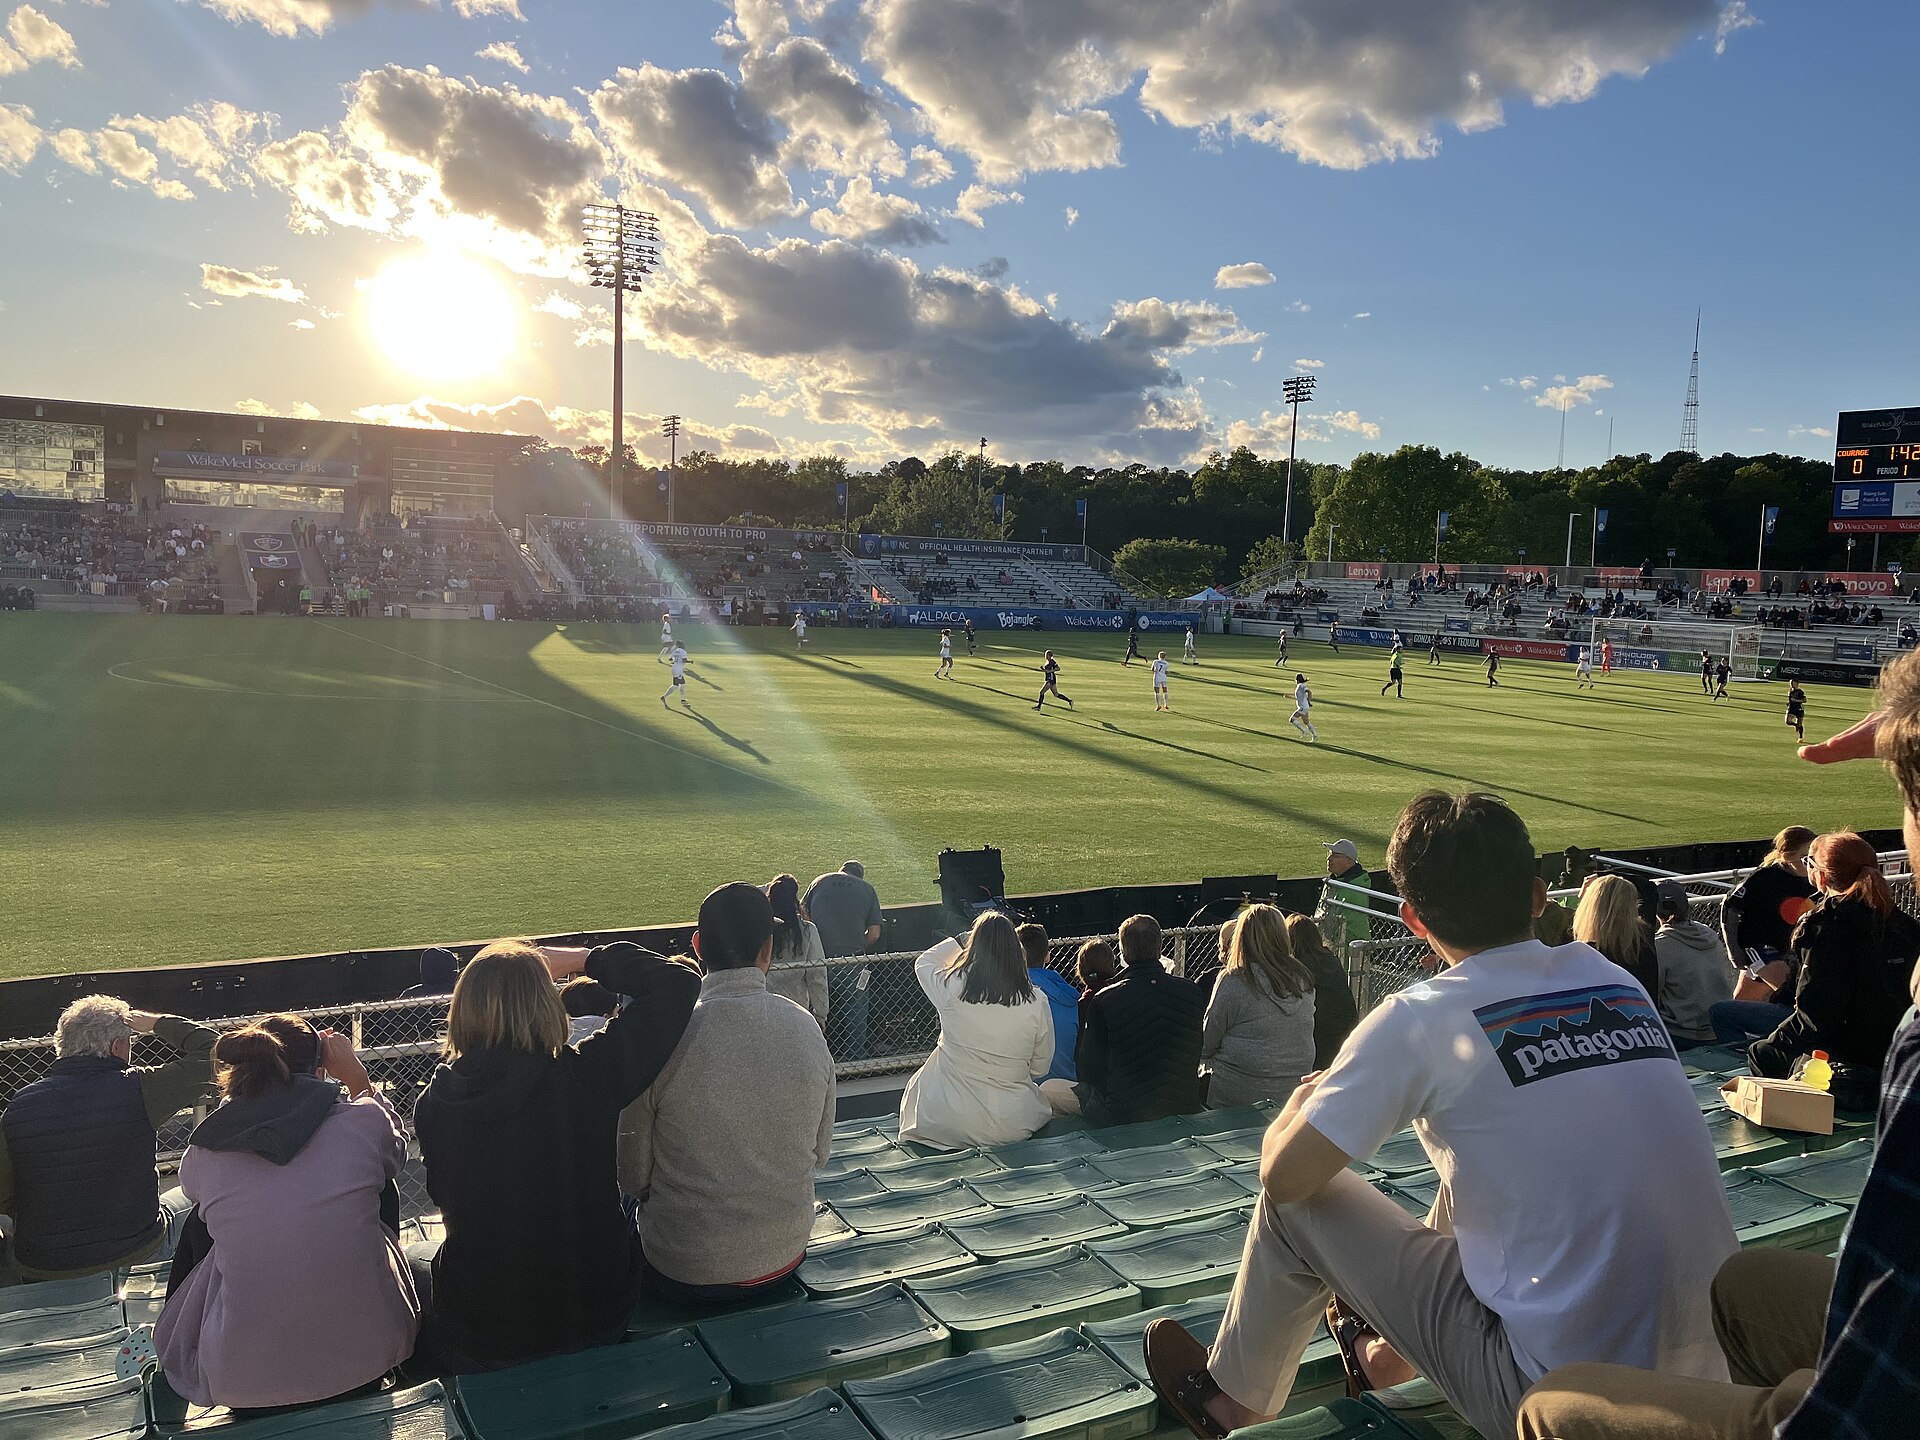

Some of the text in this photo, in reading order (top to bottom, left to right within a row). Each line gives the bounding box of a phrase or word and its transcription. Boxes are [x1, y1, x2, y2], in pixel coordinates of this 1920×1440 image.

[1837, 449, 1869, 457] COURAGE
[186, 453, 326, 473] WakeMed Soccer Park
[1852, 459, 1863, 474] 0
[1877, 467, 1898, 475] PERIOD
[563, 521, 577, 530] NC
[620, 523, 766, 540] SUPPORTING YOUTH TO PRO
[898, 541, 910, 550] NC
[920, 542, 1053, 556] OFFICIAL HEALTH INSURANCE PARTNER
[1348, 565, 1380, 577] Lenovo
[920, 611, 966, 621] ALPACA
[1064, 615, 1111, 626] WakeMed
[1458, 638, 1480, 648] TEQUILA
[1526, 646, 1560, 656] WakeMed
[1780, 667, 1800, 675] MERZ
[1511, 1021, 1669, 1078] patagonia
